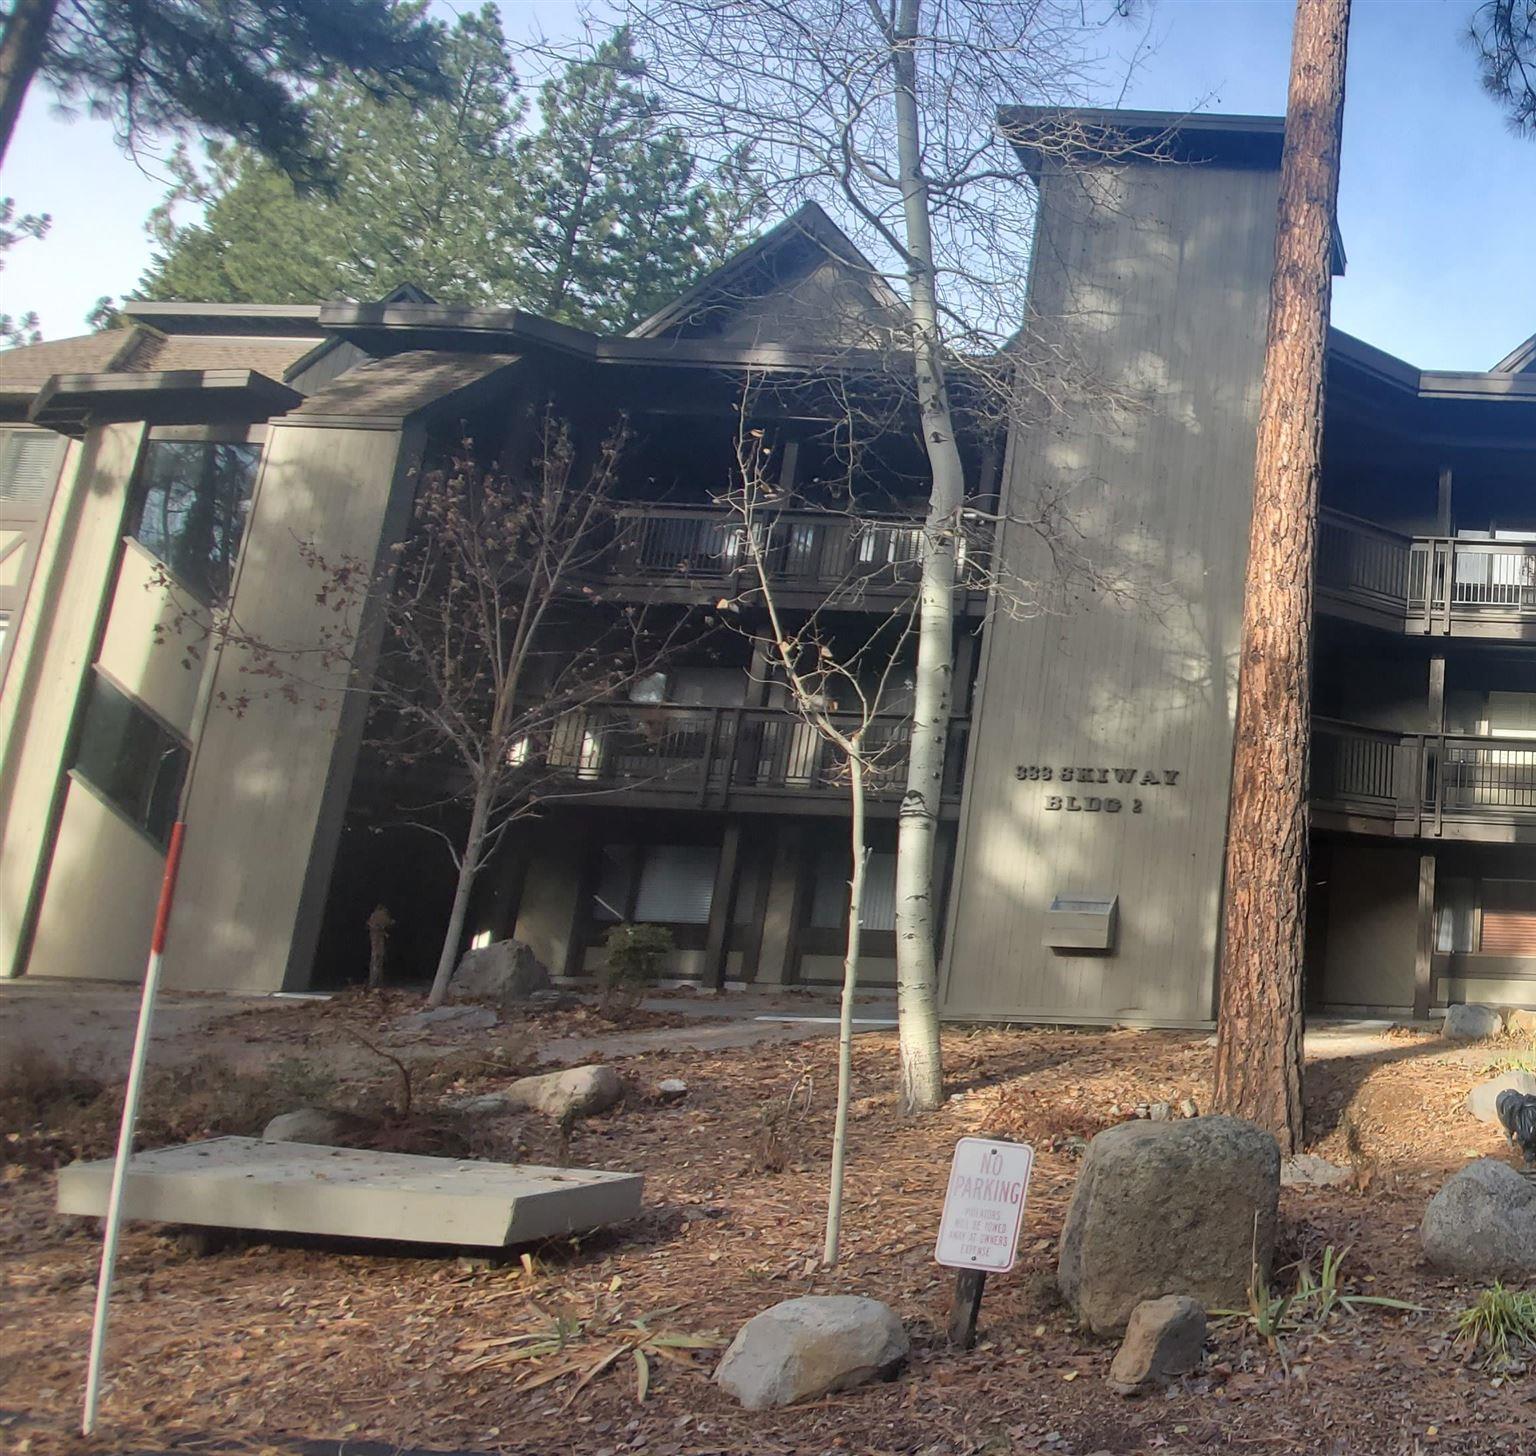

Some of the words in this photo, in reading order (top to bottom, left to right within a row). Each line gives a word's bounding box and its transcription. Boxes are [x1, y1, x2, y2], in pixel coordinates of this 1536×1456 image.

[1015, 766, 1053, 781] 333
[1060, 767, 1180, 786] SKIWAY
[1045, 796, 1123, 813] BLDG
[1132, 799, 1144, 814] 2
[980, 1153, 1004, 1176] NO
[954, 1175, 1022, 1205] PARKING
